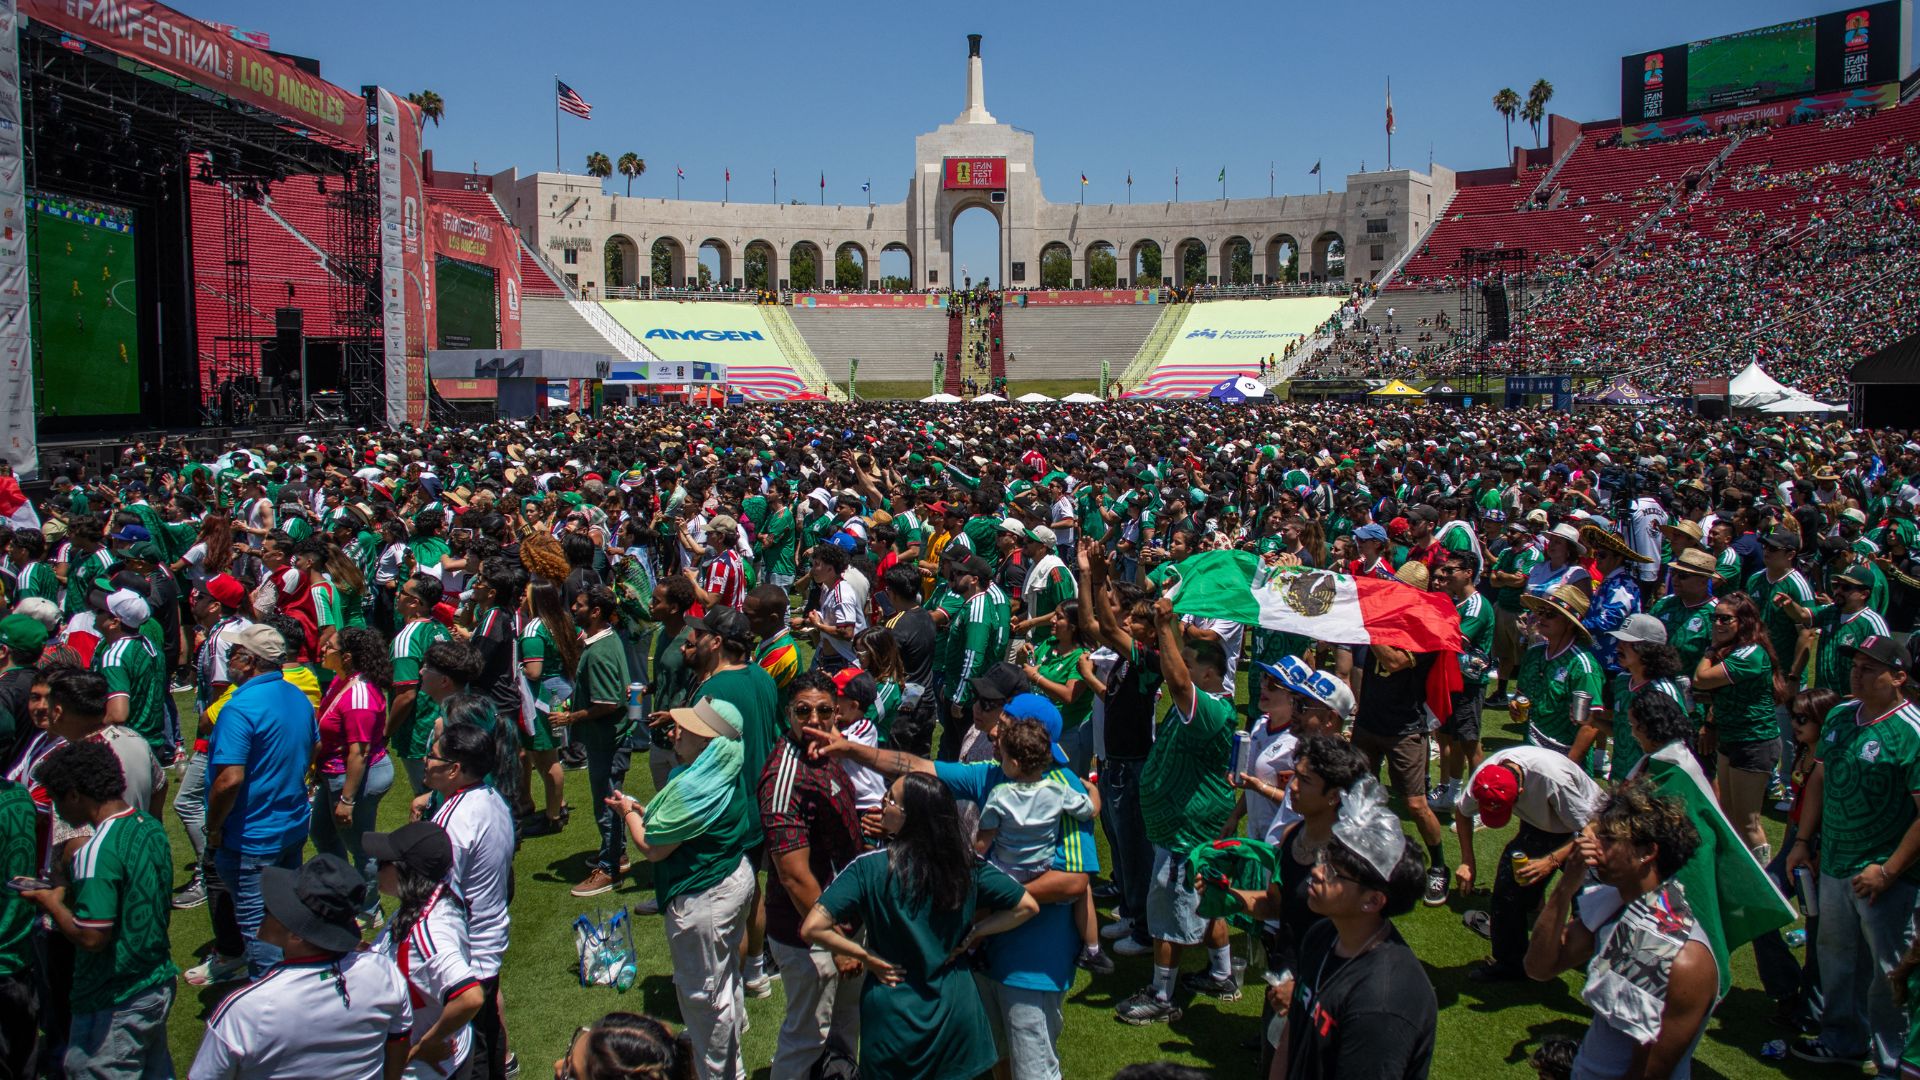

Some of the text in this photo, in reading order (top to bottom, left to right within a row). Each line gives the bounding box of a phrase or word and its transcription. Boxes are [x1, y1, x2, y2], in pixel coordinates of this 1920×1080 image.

[1849, 54, 1868, 65] FAN
[1845, 63, 1868, 76] FEST
[240, 56, 274, 97] LOS
[277, 73, 345, 126] ANGELES
[1644, 99, 1663, 110] FEST
[0, 117, 14, 131] ISA
[976, 162, 992, 170] FAN
[973, 169, 993, 178] FEST
[644, 328, 766, 342] AMGEN
[1220, 332, 1304, 340] Permanente
[1642, 507, 1665, 518] MEXICO
